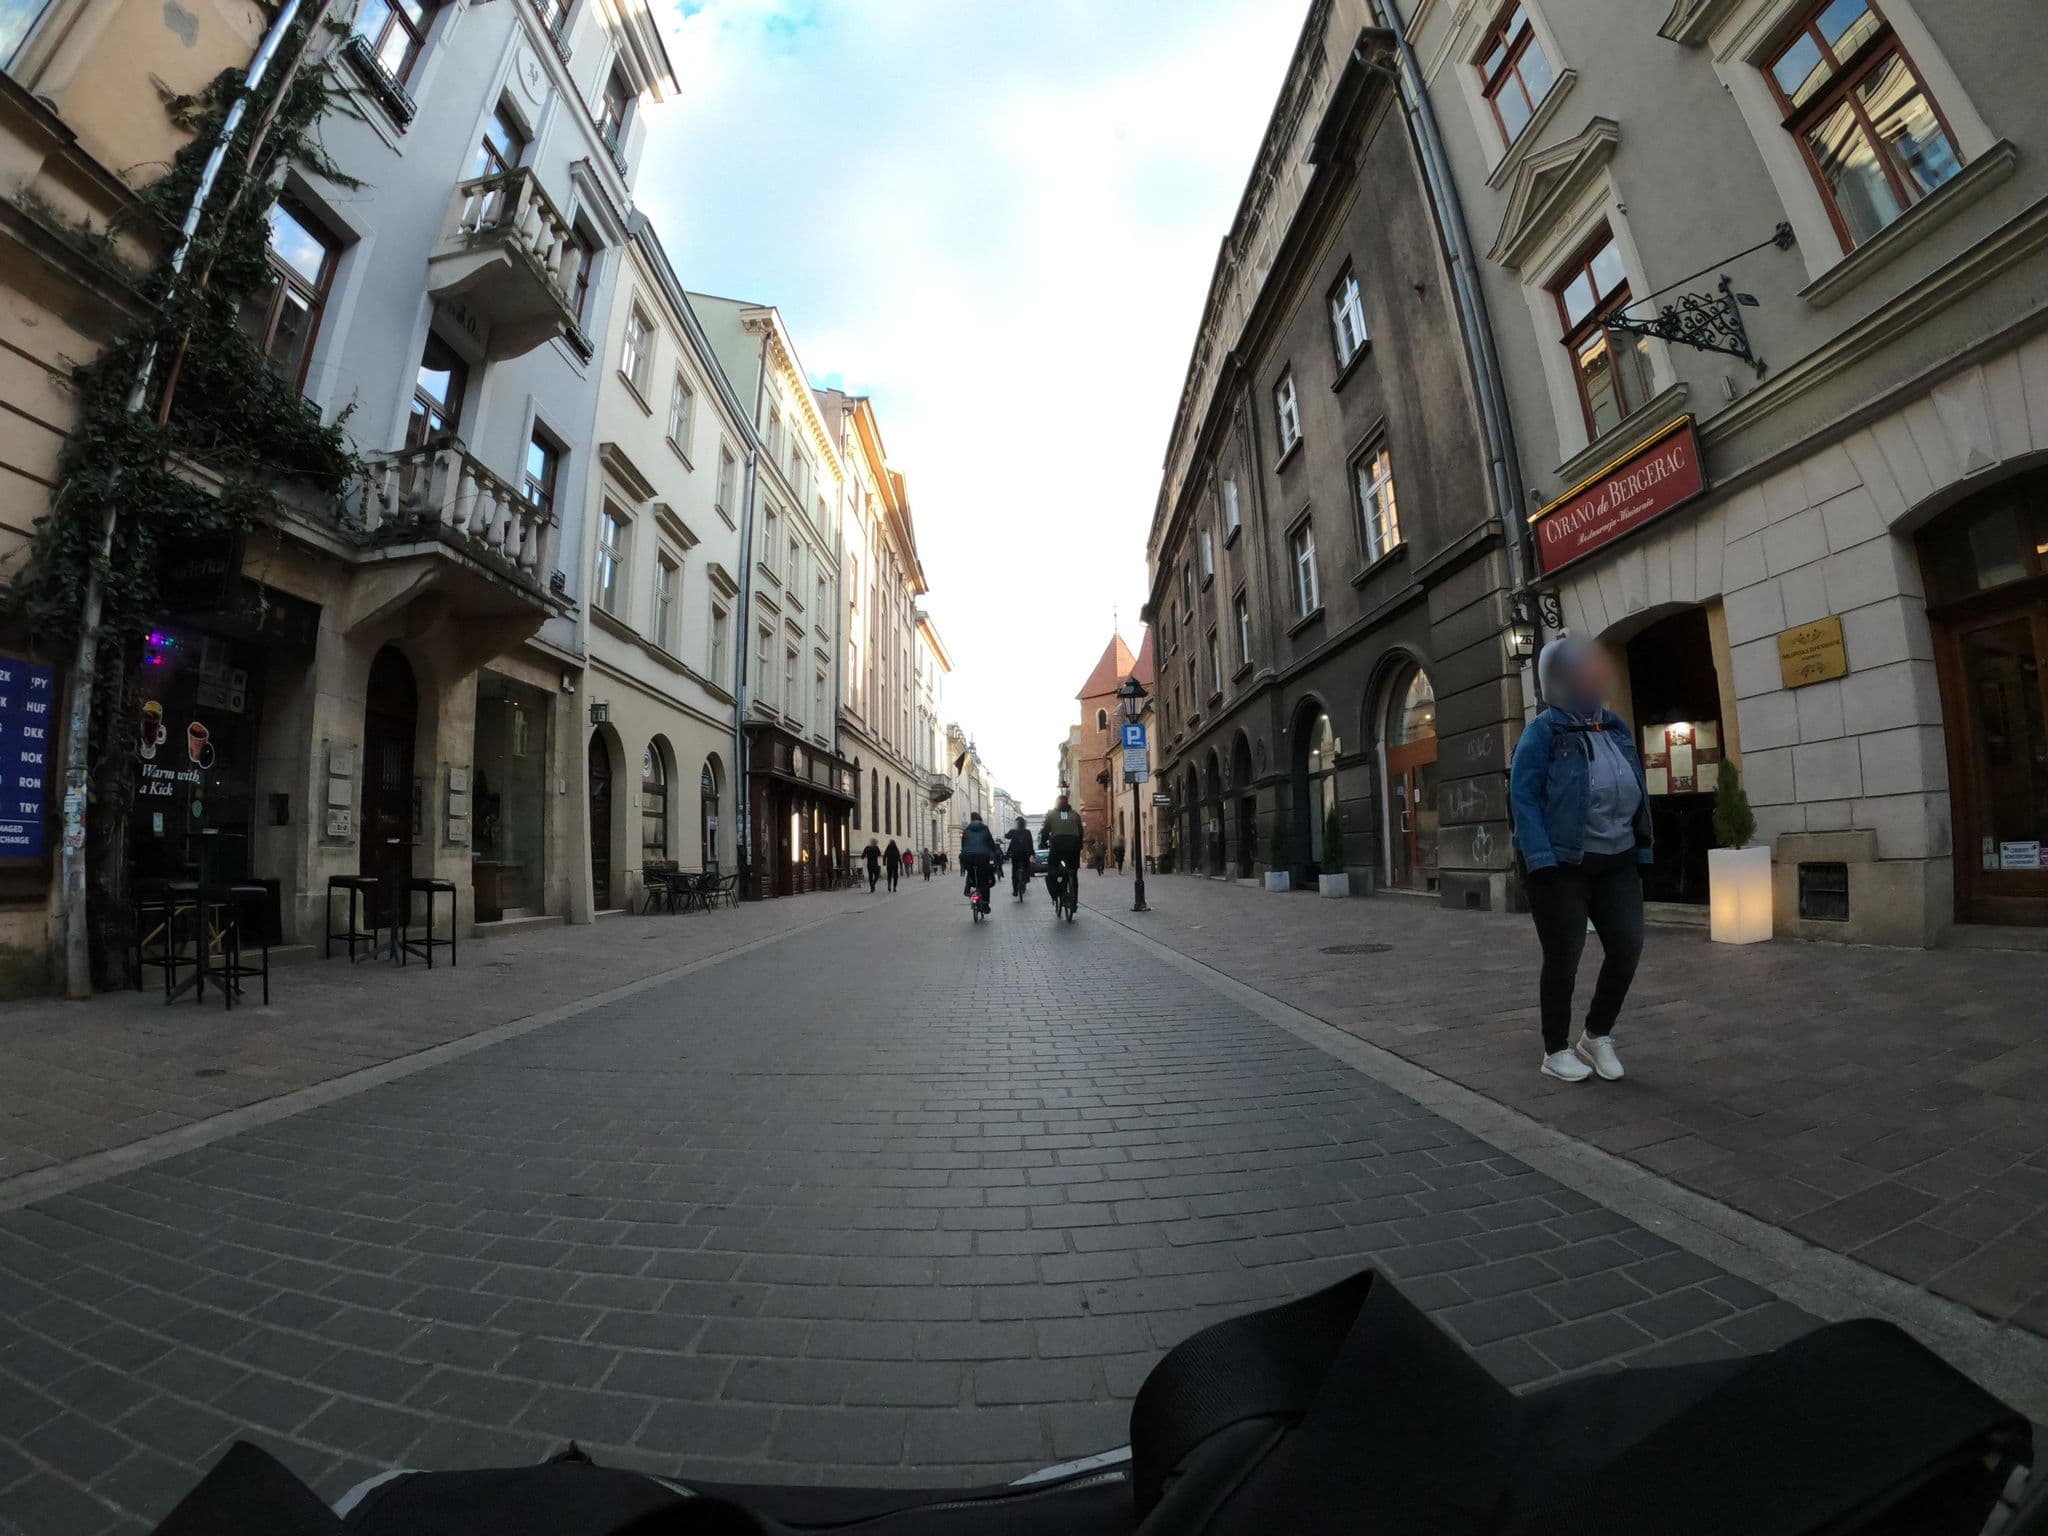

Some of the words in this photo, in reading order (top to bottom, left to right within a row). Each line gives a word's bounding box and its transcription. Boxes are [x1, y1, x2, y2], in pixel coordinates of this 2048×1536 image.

[1546, 501, 1595, 544] CYRANO
[1597, 495, 1609, 517] de
[1608, 447, 1685, 509] BERGERAC
[1520, 634, 1533, 646] 26
[27, 701, 47, 714] HUF
[24, 726, 44, 739] DKK
[1127, 727, 1141, 745] P
[21, 751, 42, 764] NOK
[142, 764, 175, 780] Warm
[177, 769, 200, 782] with
[19, 776, 41, 789] RON
[139, 784, 147, 794] a
[149, 781, 174, 796] Kick
[19, 802, 39, 814] TRY
